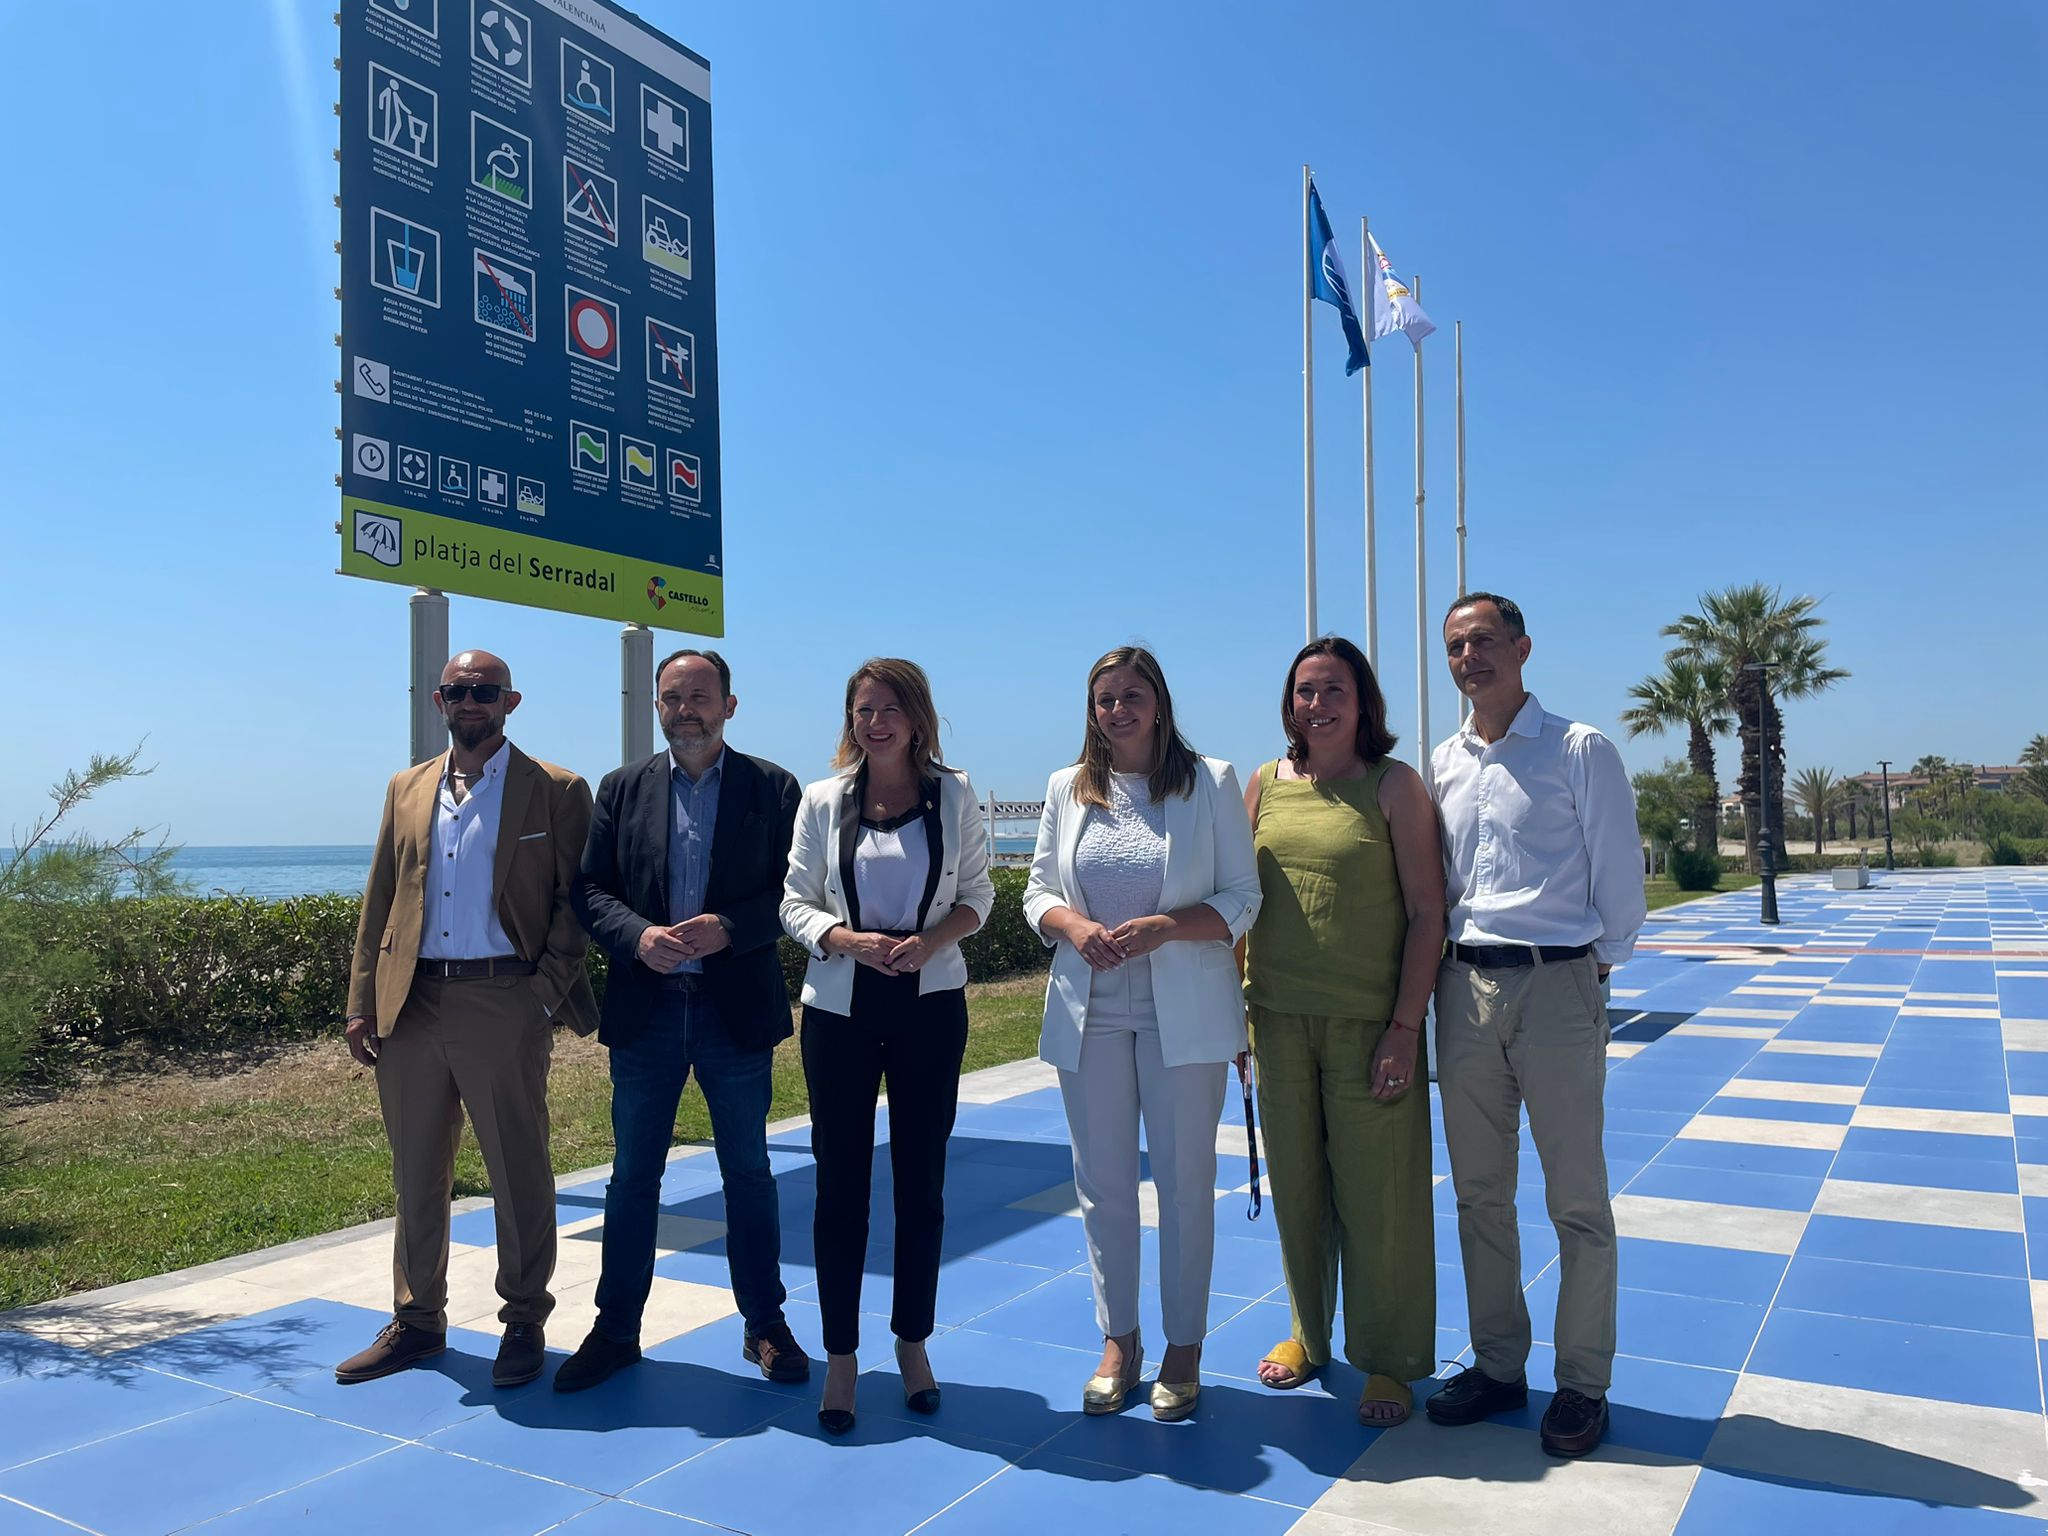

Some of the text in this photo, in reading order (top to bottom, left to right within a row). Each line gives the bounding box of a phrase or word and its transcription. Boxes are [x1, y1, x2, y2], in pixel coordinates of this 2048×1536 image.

[366, 26, 384, 38] CLEAN
[398, 176, 430, 194] COLLECTION
[410, 172, 433, 187] BASURAS
[481, 237, 502, 250] COASTAL
[399, 302, 422, 314] POTABLE
[399, 312, 422, 324] POTABLE
[410, 324, 428, 334] WATER
[412, 385, 426, 394] LOCAL
[447, 396, 460, 404] LOCAL
[478, 405, 493, 413] POLICE
[415, 535, 615, 593] platja del Serradal
